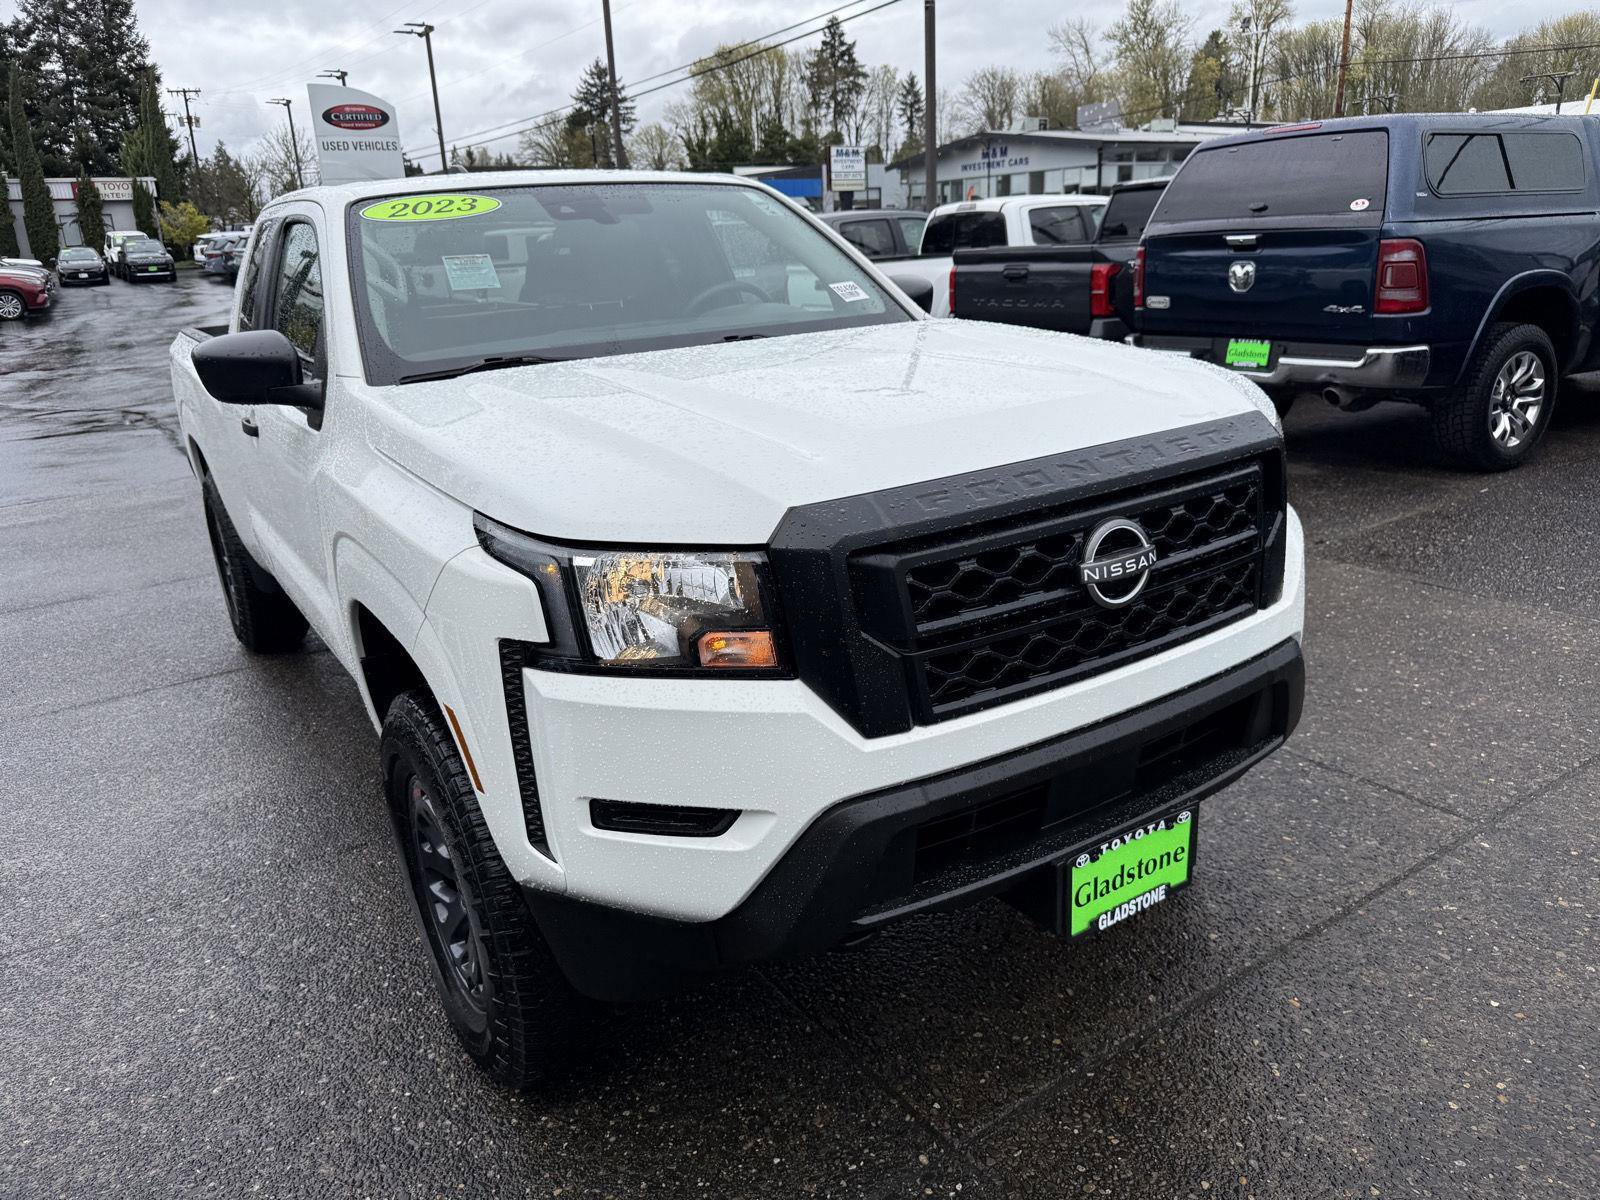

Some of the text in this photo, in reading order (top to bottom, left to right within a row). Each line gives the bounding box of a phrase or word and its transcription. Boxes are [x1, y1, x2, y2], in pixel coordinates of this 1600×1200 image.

[322, 140, 398, 152] USED VEHICLES
[1008, 157, 1029, 167] CARS
[388, 197, 478, 218] 2023
[973, 298, 1065, 308] TACOMA
[914, 427, 1240, 513] FRONTIER
[1083, 549, 1158, 582] NISSAN
[1100, 819, 1166, 855] TOYOTA
[1074, 845, 1185, 908] Gladstone
[1098, 884, 1166, 931] GLADSTONE
